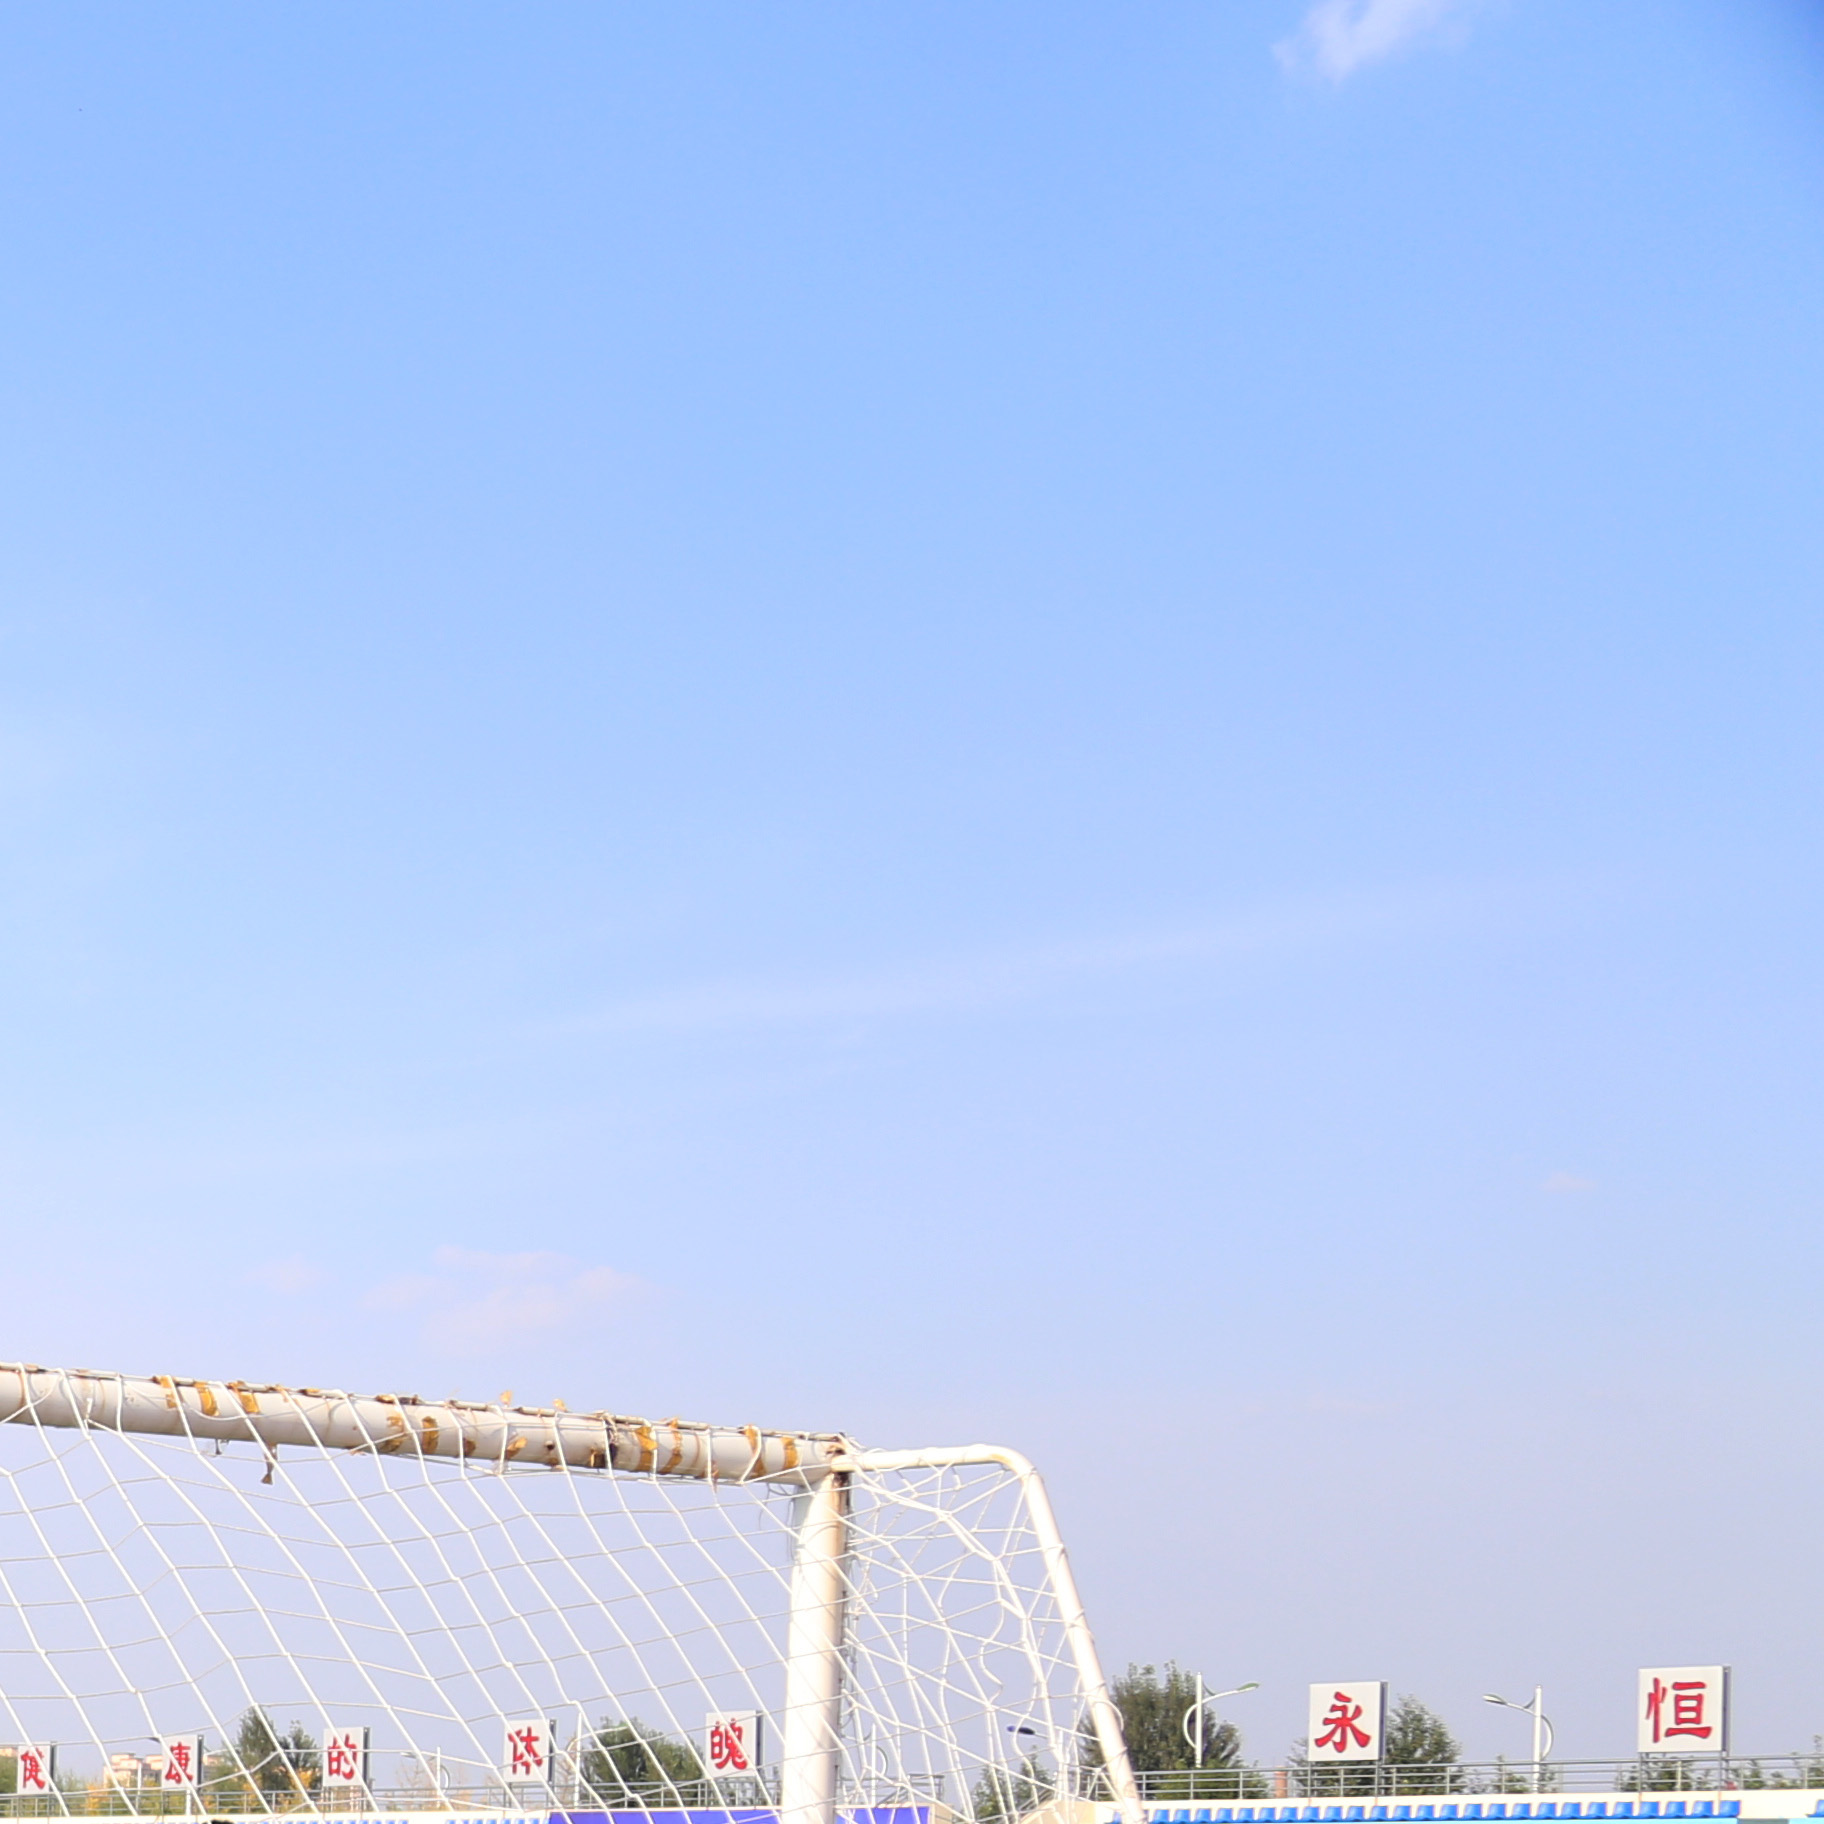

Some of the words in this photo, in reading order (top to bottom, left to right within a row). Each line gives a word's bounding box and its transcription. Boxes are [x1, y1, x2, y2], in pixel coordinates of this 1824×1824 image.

[1314, 1692, 1371, 1753] 永
[1645, 1677, 1713, 1744] 恒
[165, 1741, 193, 1784] 康
[327, 1734, 358, 1780] 的
[507, 1726, 543, 1775] 体
[710, 1718, 749, 1770] 魄
